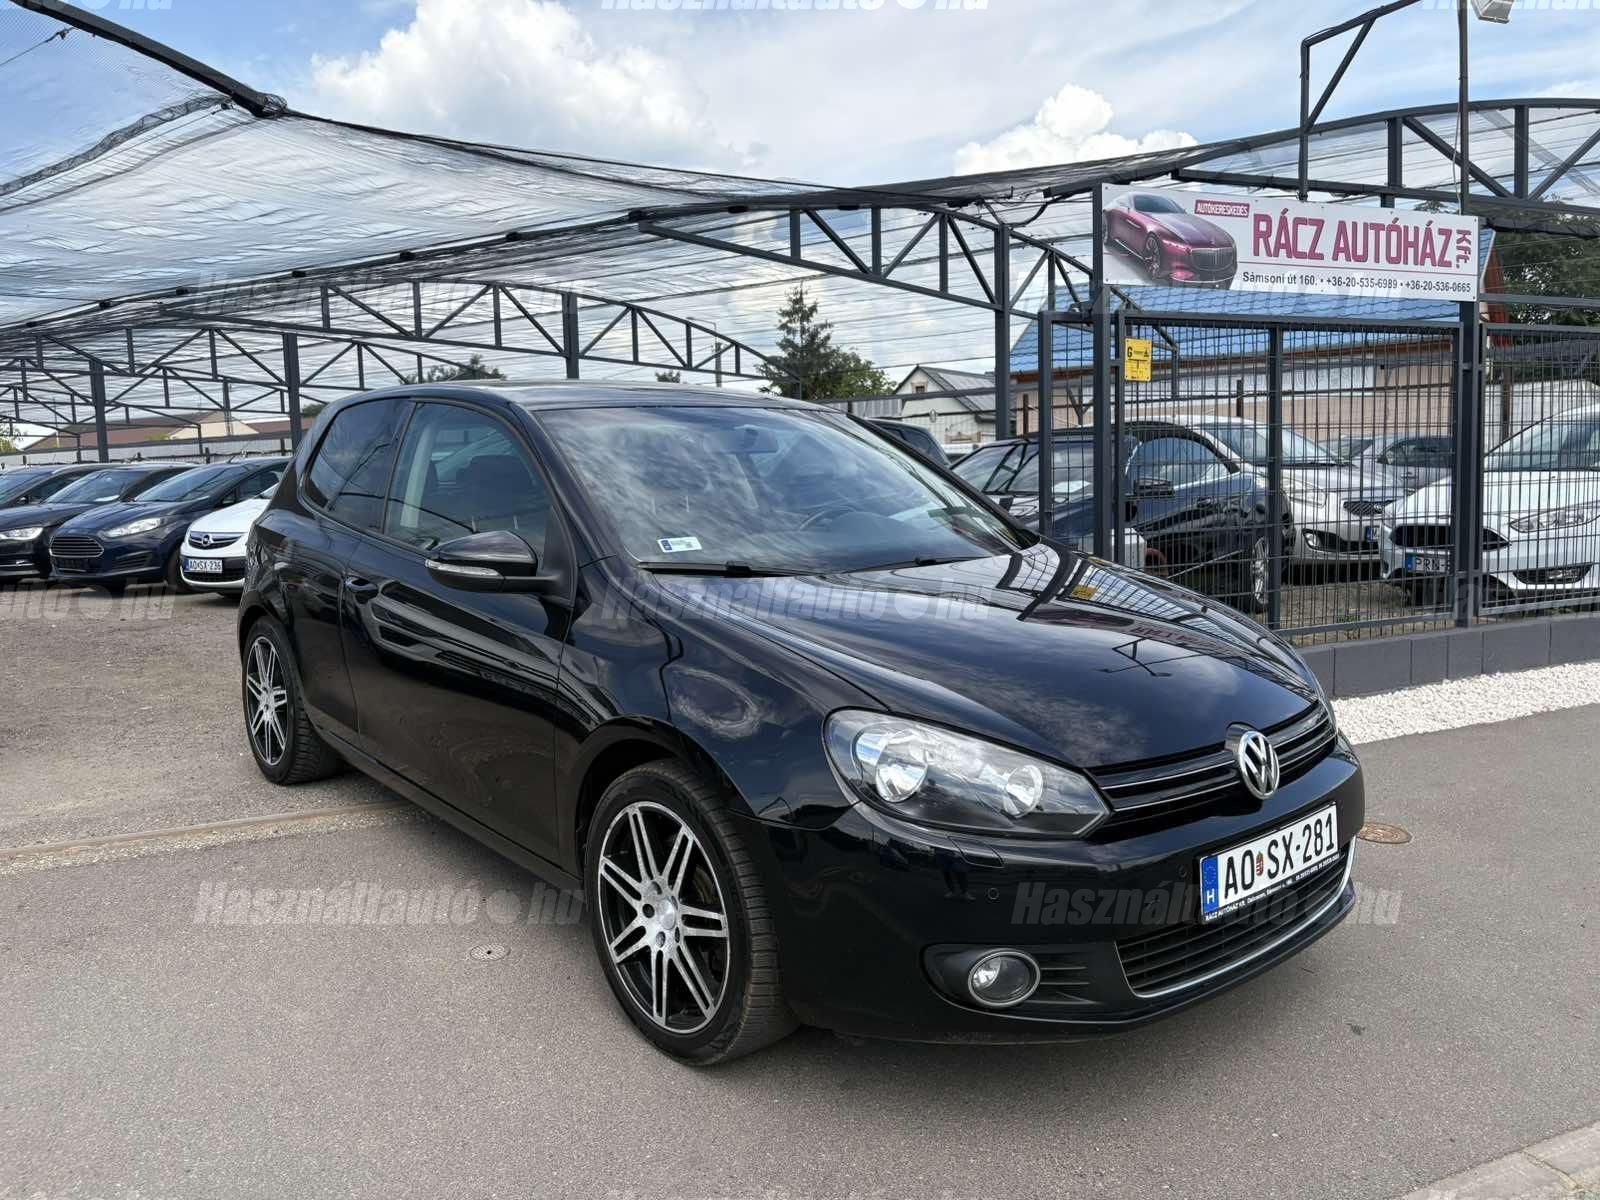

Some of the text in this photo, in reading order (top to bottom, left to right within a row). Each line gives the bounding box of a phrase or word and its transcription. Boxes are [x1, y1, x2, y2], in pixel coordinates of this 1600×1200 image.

[1197, 202, 1248, 216] AUTÓKERESKEDÉS
[1253, 208, 1452, 268] RÁCZ AUTÓHÁZ
[1242, 271, 1284, 284] Sámsoni
[1287, 273, 1296, 284] út
[1299, 275, 1318, 285] 160.
[1326, 276, 1398, 289] +36-20-535-6989
[1224, 849, 1255, 900] AO
[1266, 812, 1335, 880] SX-281
[1206, 888, 1216, 905] H
